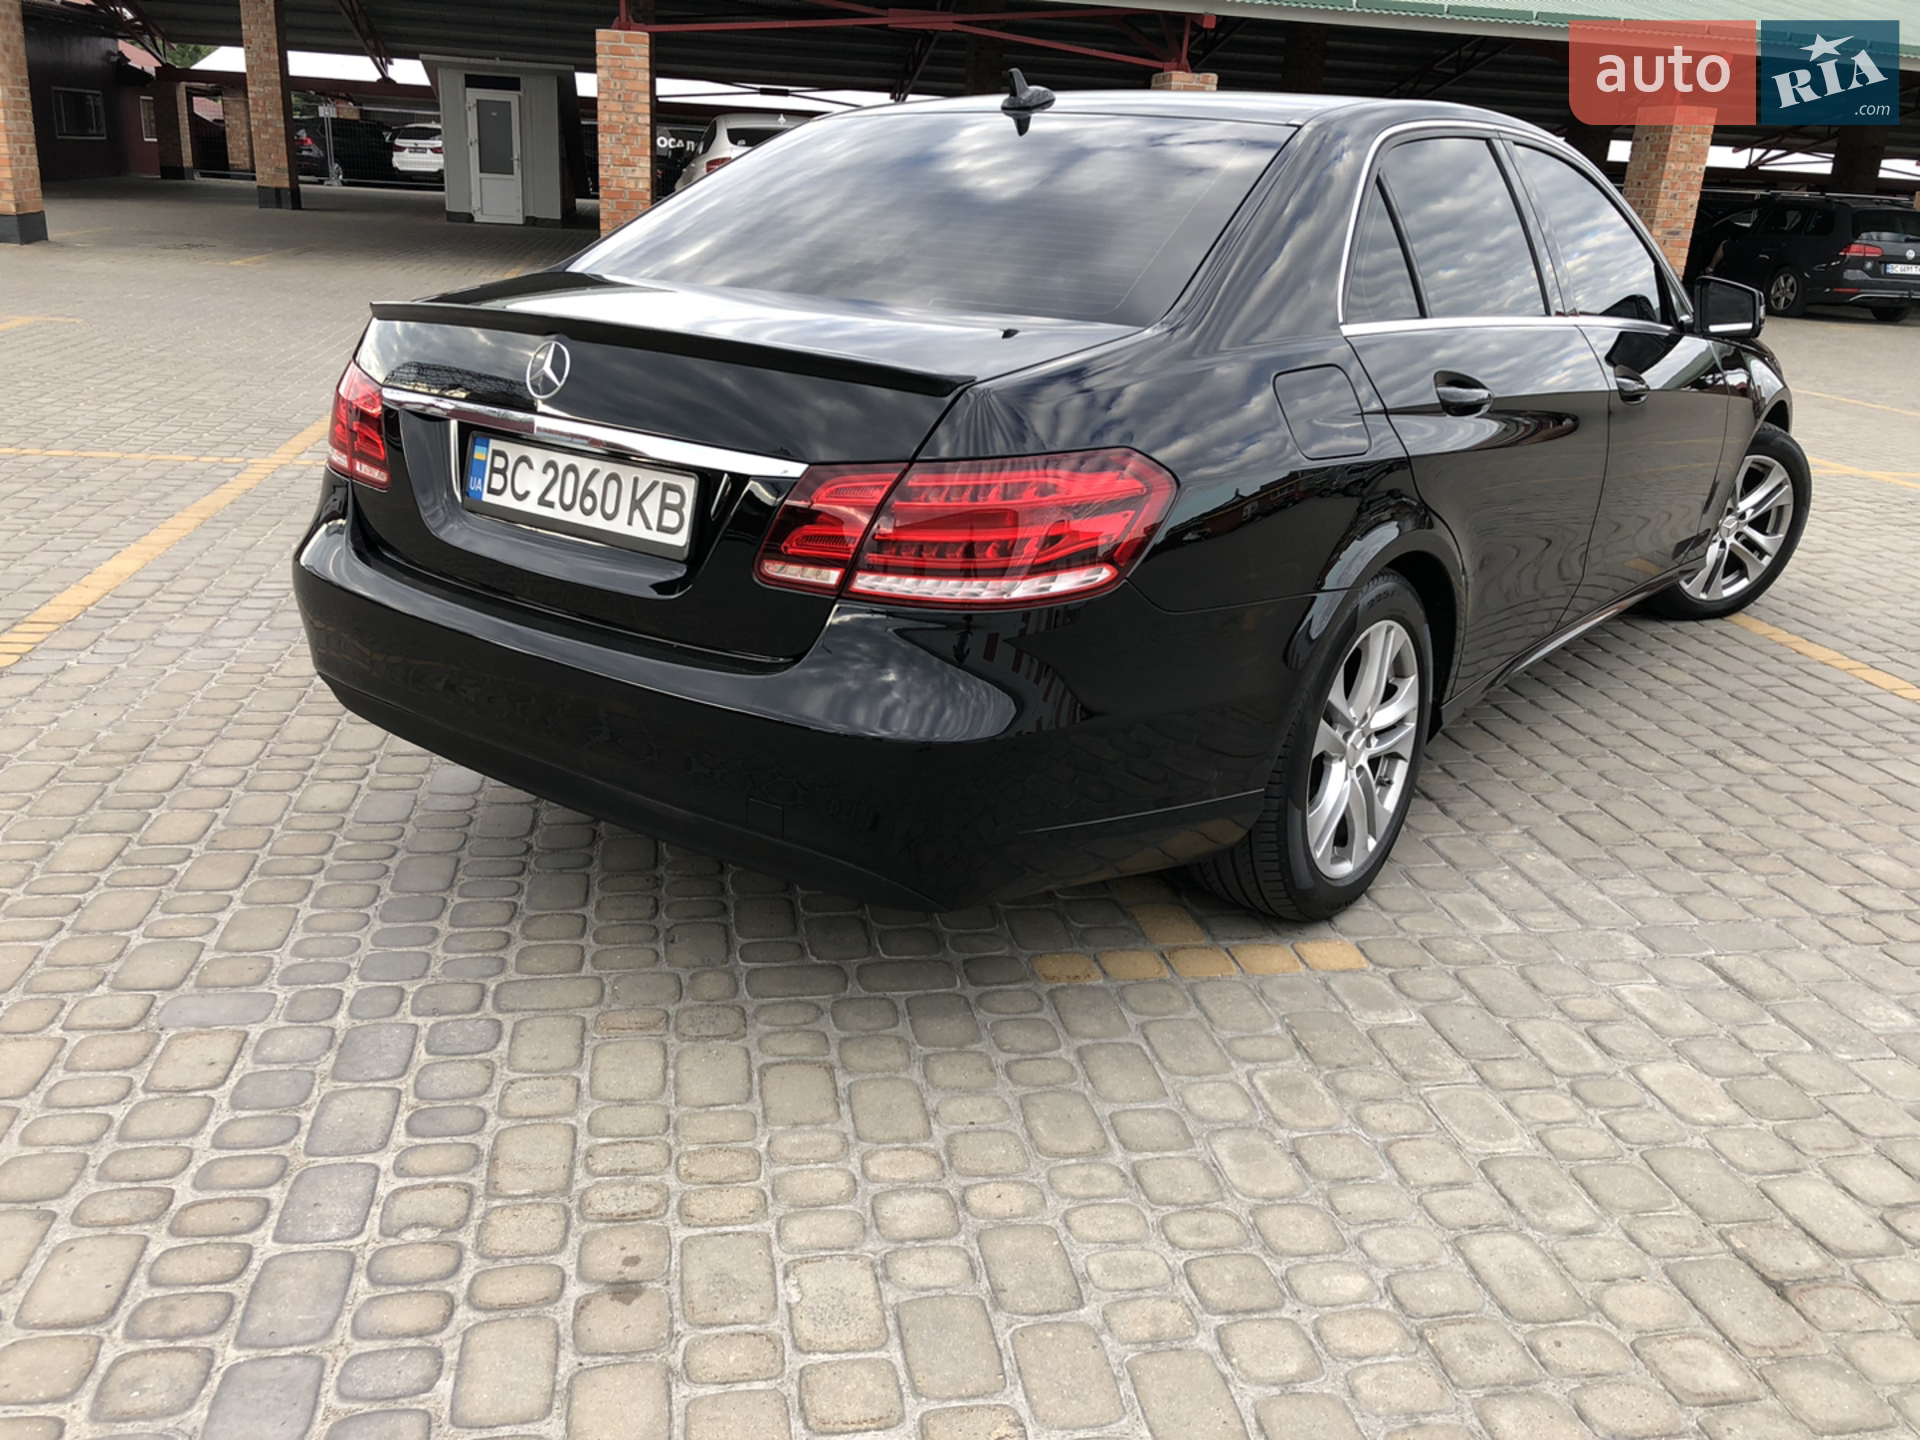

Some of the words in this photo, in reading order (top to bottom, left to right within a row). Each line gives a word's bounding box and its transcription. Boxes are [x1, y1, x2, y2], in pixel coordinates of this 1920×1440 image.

[469, 476, 482, 491] UA
[486, 449, 534, 502] BC
[537, 459, 623, 521] 2060
[627, 476, 687, 535] KB
